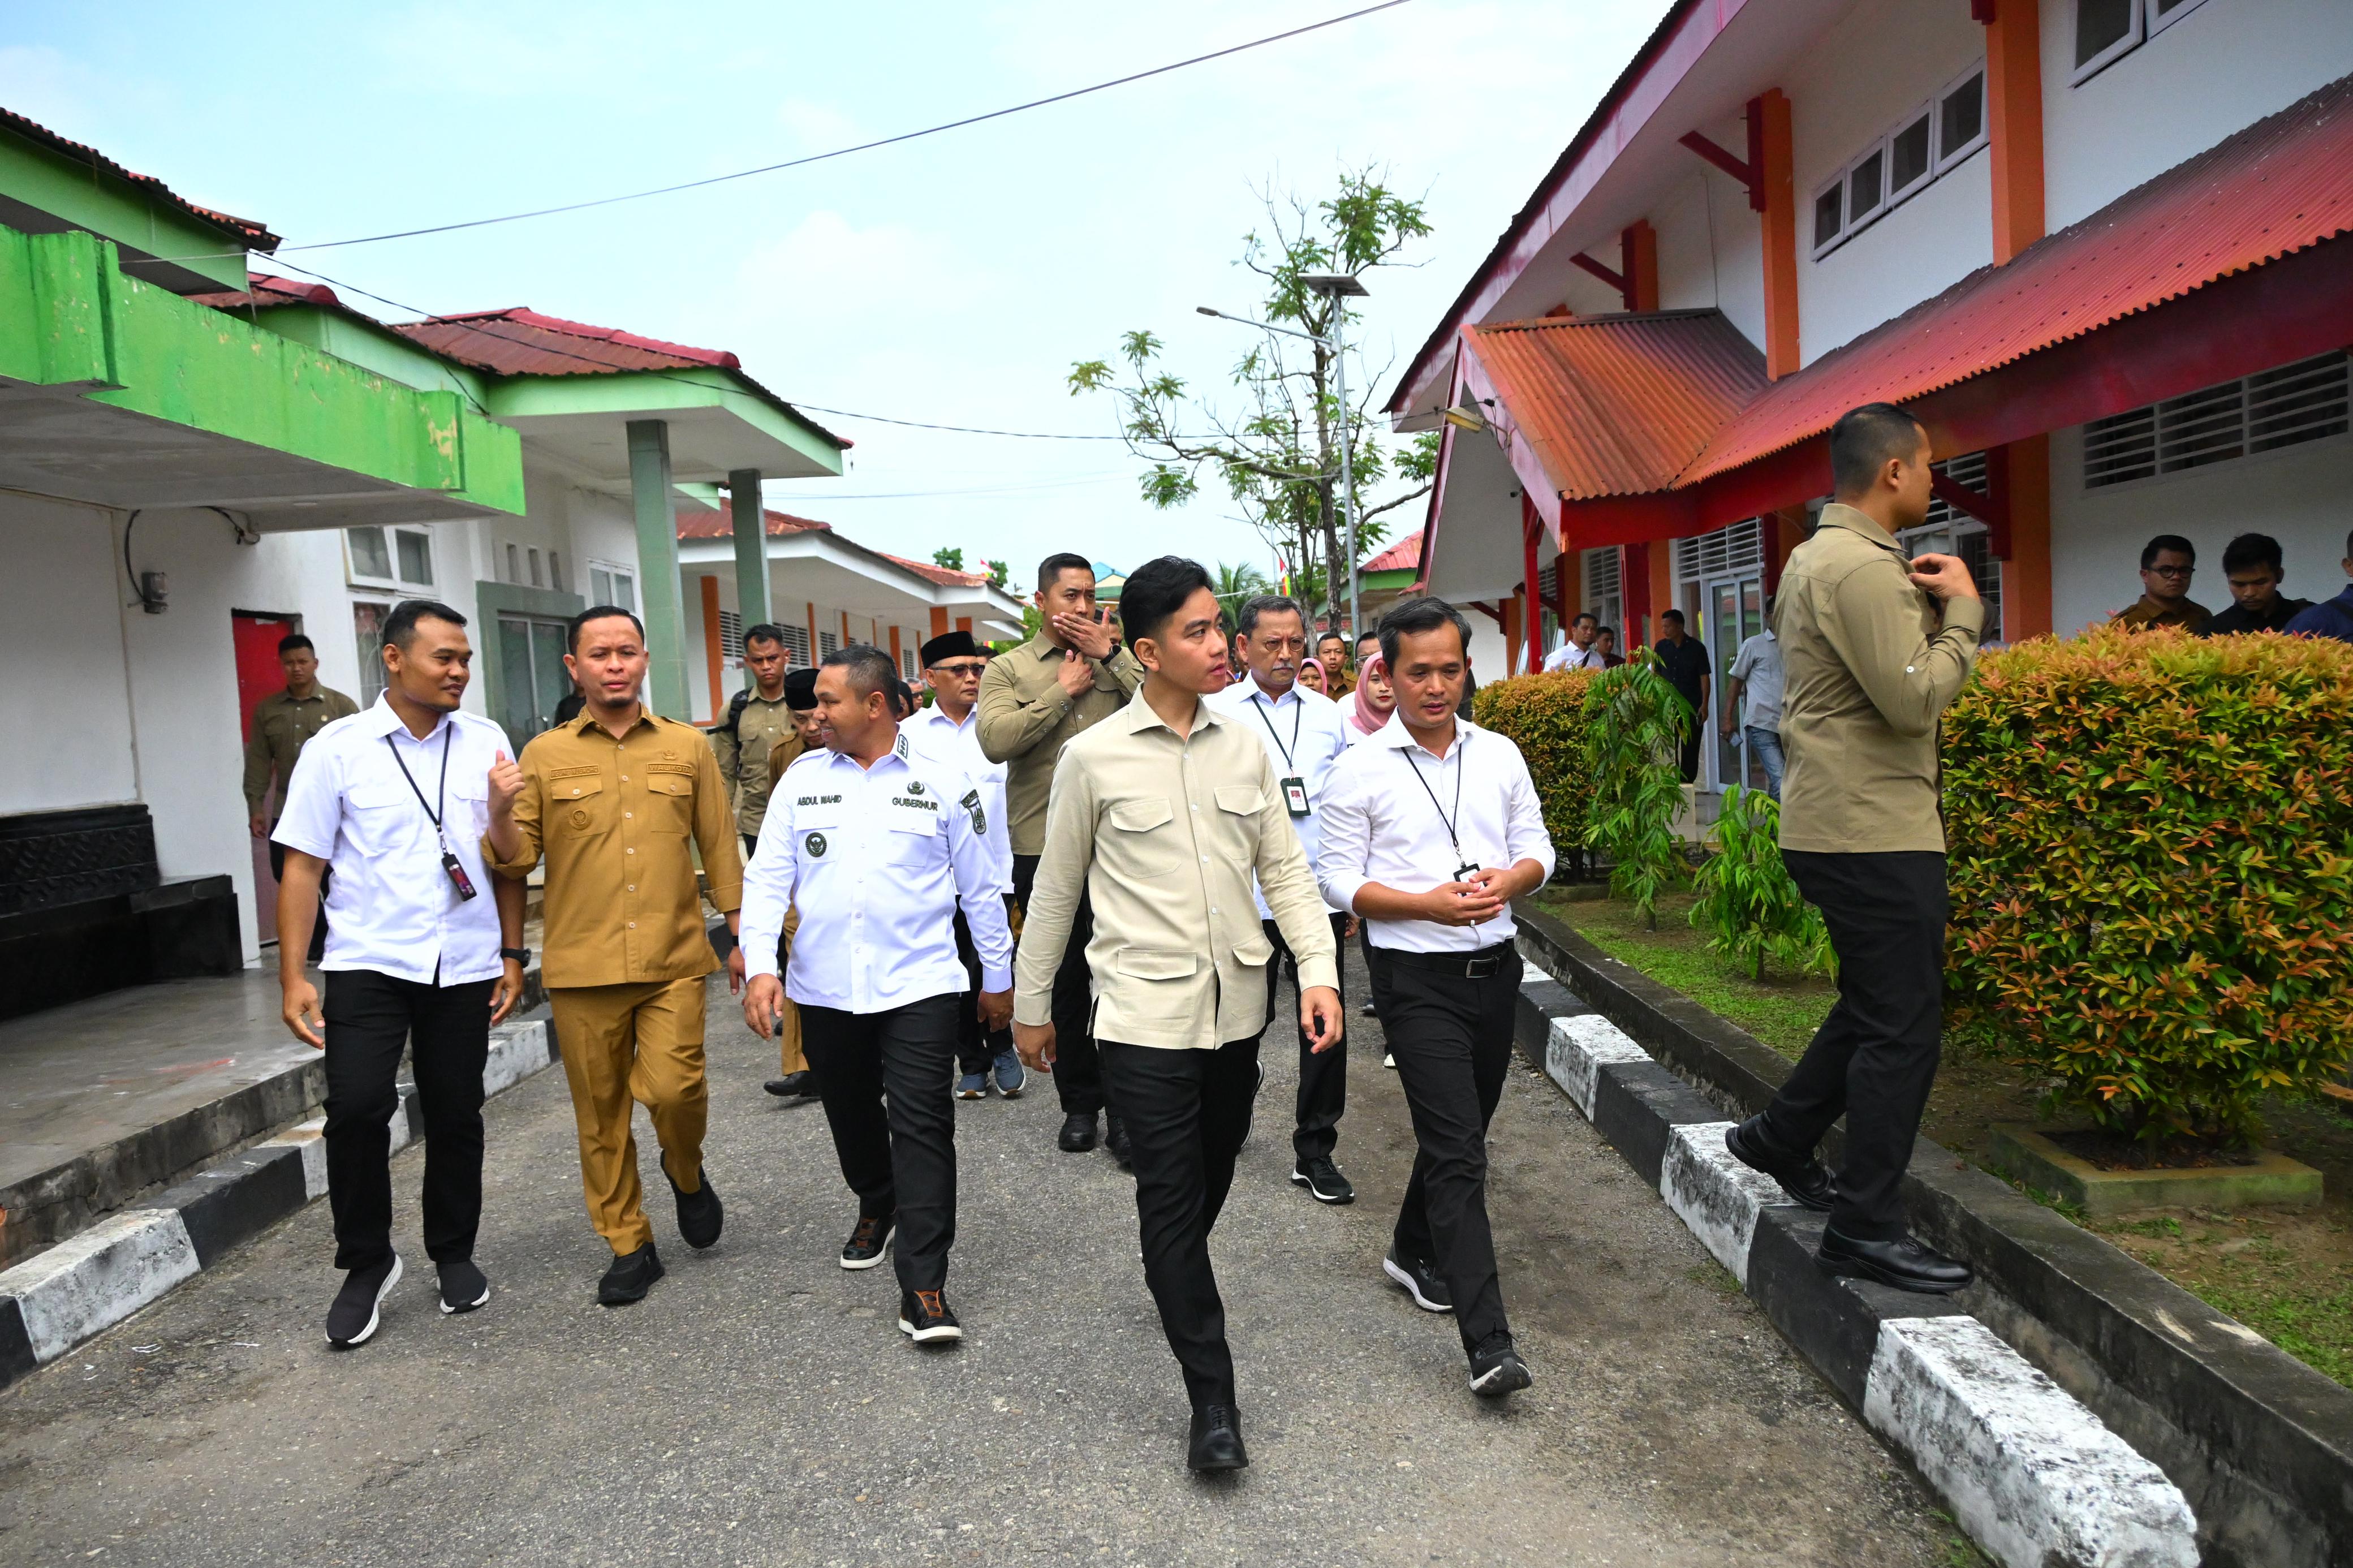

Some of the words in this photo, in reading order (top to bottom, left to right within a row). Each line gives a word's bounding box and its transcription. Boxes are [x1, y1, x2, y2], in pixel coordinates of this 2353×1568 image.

[797, 796, 818, 806] ABDUL
[821, 795, 842, 804] WAHID
[892, 796, 938, 812] GUBERNUR
